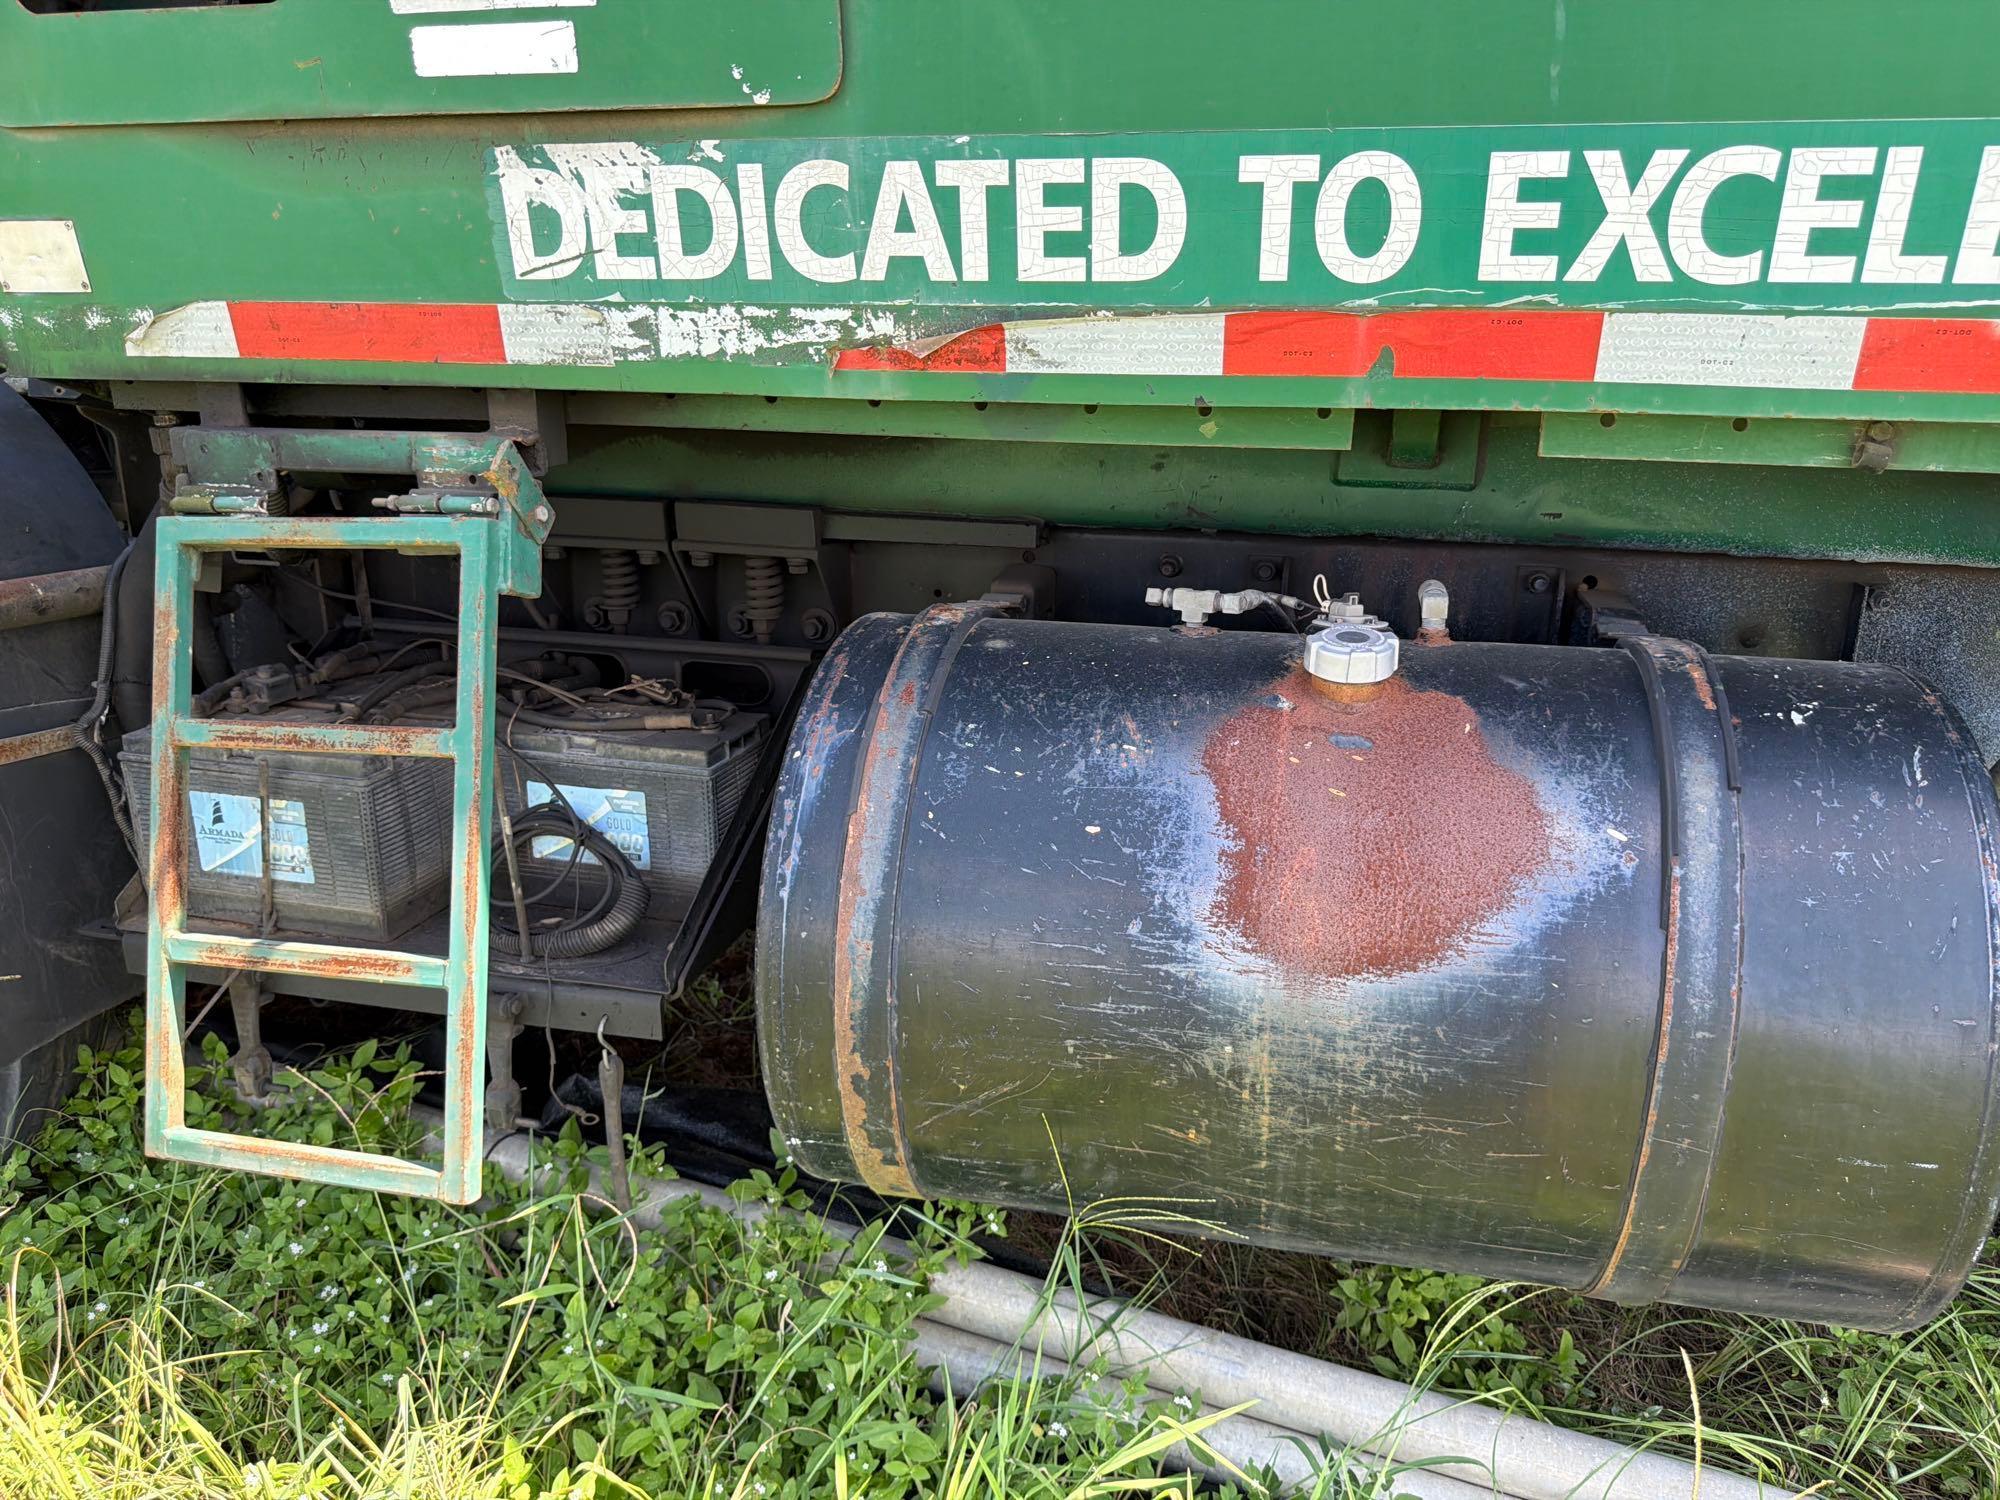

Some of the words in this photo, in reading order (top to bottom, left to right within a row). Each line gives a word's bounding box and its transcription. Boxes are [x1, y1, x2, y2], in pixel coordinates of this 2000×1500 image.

[498, 157, 1187, 284] DEDICATED
[1239, 150, 1422, 284] TO
[606, 816, 632, 831] GOLD
[199, 825, 245, 840] ARMADA
